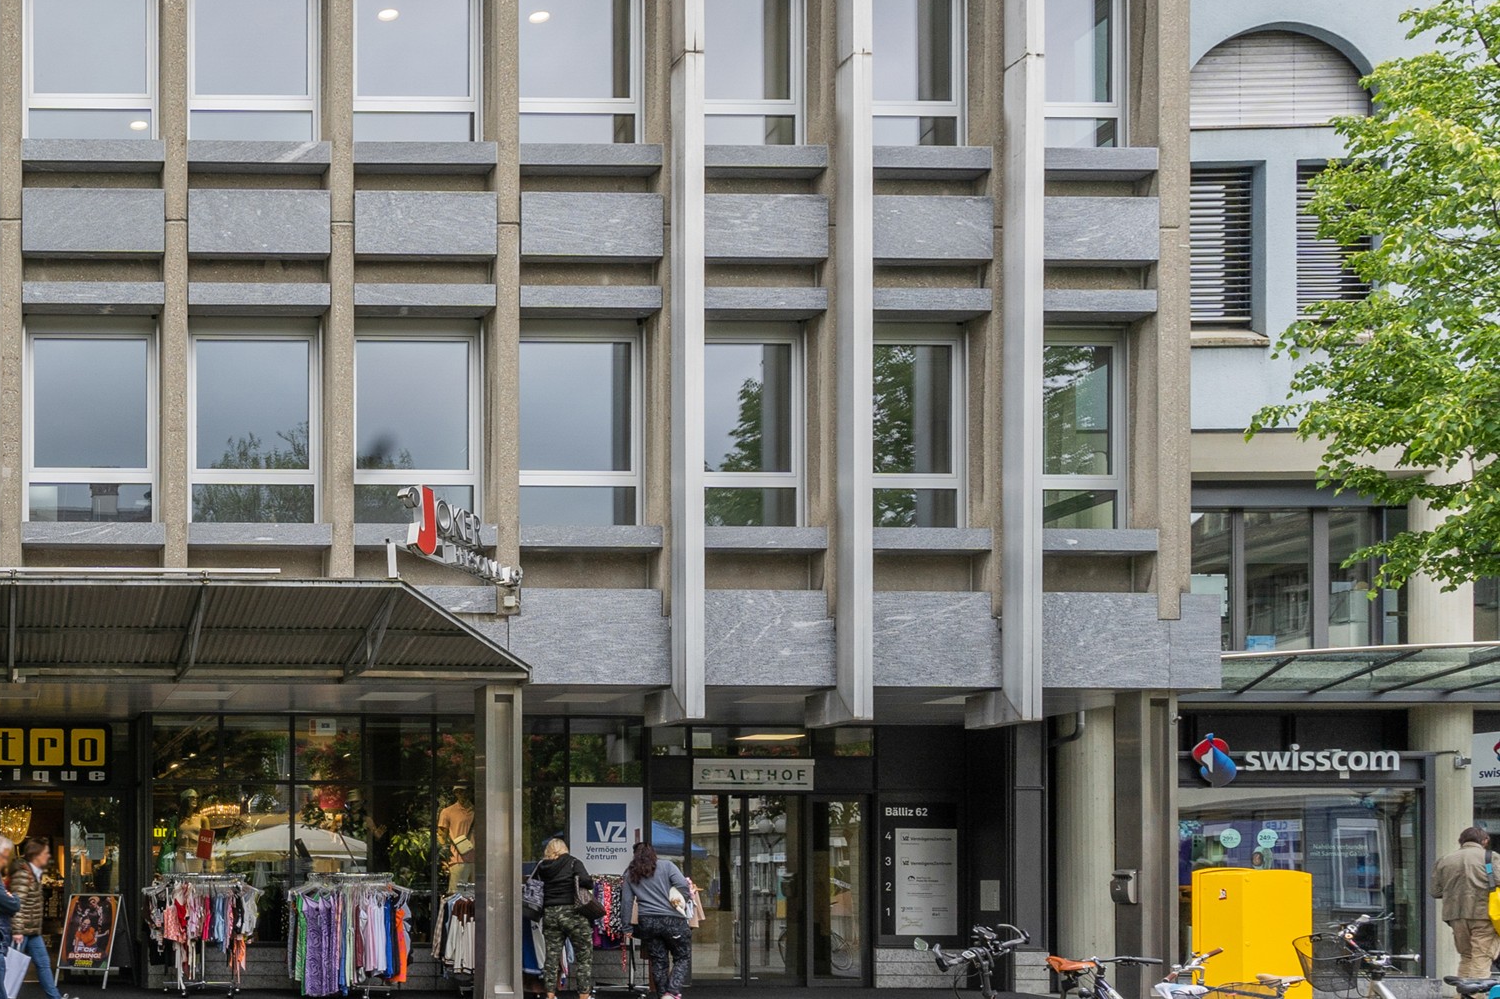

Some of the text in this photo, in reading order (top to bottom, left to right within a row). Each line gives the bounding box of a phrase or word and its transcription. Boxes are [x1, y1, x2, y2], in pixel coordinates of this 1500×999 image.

[397, 485, 483, 555] JOKER
[1245, 743, 1400, 771] swisscom
[701, 768, 806, 781] STADTHOF
[885, 807, 928, 817] Bälliz 62
[594, 821, 627, 842] VZ
[885, 832, 892, 840] 4
[586, 846, 627, 854] Vermögens
[885, 856, 892, 866] 3
[885, 882, 892, 892] 2
[886, 907, 891, 916] 1
